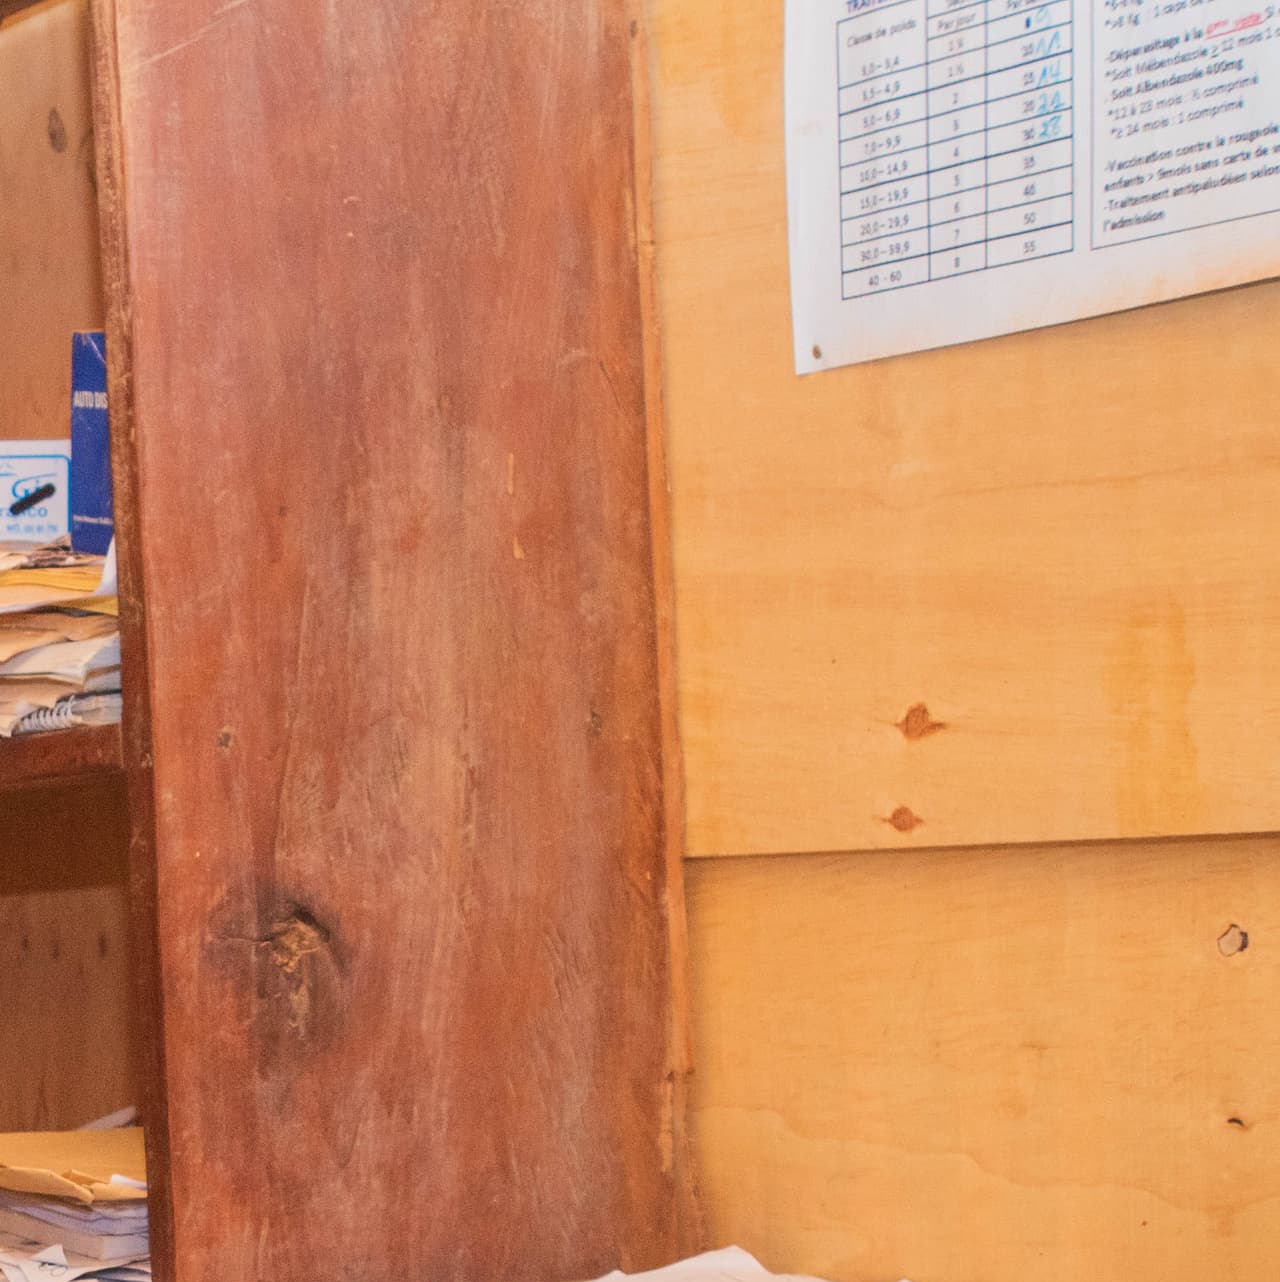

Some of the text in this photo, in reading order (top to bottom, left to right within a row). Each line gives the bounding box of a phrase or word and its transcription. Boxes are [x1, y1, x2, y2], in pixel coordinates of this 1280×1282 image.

[889, 18, 918, 38] poids
[1192, 26, 1203, 39] la
[1222, 37, 1234, 52] 12
[1238, 31, 1263, 46] mois
[1134, 69, 1203, 94] Albendazole
[1205, 57, 1244, 75] 400mg
[1156, 95, 1182, 110] mois
[1203, 74, 1259, 99] comprimé
[1142, 117, 1171, 132] mois
[1187, 98, 1244, 122] comprimé
[1176, 140, 1213, 158] contre
[1229, 123, 1280, 144] rougeole
[1105, 175, 1145, 193] enfants
[1194, 159, 1219, 171] sans
[1222, 150, 1251, 166] carte
[1255, 145, 1268, 158] de
[1103, 210, 1166, 233] l'admission
[868, 275, 879, 287] 40
[889, 270, 902, 284] 60
[74, 390, 94, 408] AUTO
